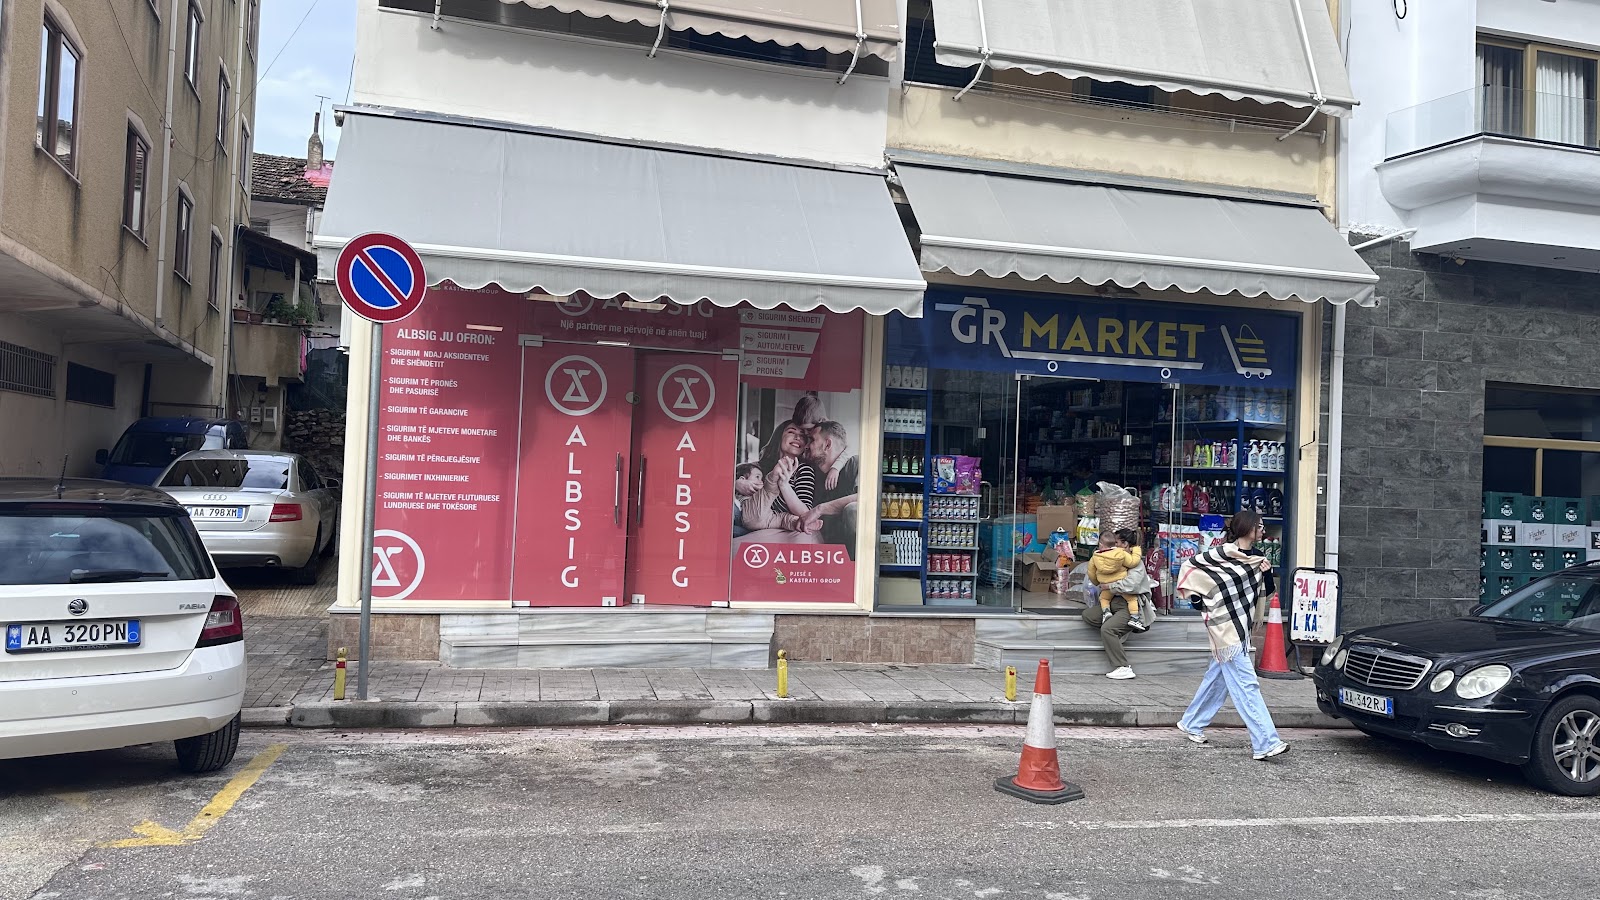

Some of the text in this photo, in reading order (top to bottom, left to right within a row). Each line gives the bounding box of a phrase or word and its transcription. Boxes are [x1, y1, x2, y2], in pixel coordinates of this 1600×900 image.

[758, 312, 787, 322] SIGURIM
[560, 320, 707, 340] Një partner me përvojë në anën tuaj!
[757, 331, 786, 340] SIGURIM
[1022, 311, 1205, 359] MARKET
[397, 328, 495, 345] ALBSIG JU OFRON:
[757, 341, 805, 352] AUTOMJETEVE
[390, 348, 489, 361] SIGURIM NDAJ AKSIDENTEVE
[391, 357, 445, 368] DHE SHËNDETIT
[757, 356, 785, 365] SIGURIM
[756, 367, 783, 376] PRONËS
[389, 377, 458, 388] SIGURIM TË PRONËS
[389, 386, 439, 396] DHE PASURISË
[387, 405, 468, 416] SIGURIM TË GARANCIVE
[386, 425, 497, 437] SIGURIM TË MJETEVE MONETARE
[387, 434, 431, 443] DHE BANKËS
[385, 453, 480, 464] SIGURIM TË PËRGJEGJËSIVE
[384, 472, 469, 482] SIGURIMET INXHINIERIKE
[383, 492, 500, 502] SIGURIM TË MJETEVE FLUTURUESE
[383, 501, 477, 511] LUNDRUESE DHE TOKËSORE
[561, 425, 587, 588] ALBSIG
[671, 431, 696, 588] ALBSIG
[194, 508, 204, 517] AA
[774, 550, 844, 564] ALBSIG
[1176, 547, 1195, 559] Skip
[27, 626, 52, 645] AA
[1345, 690, 1353, 704] AA
